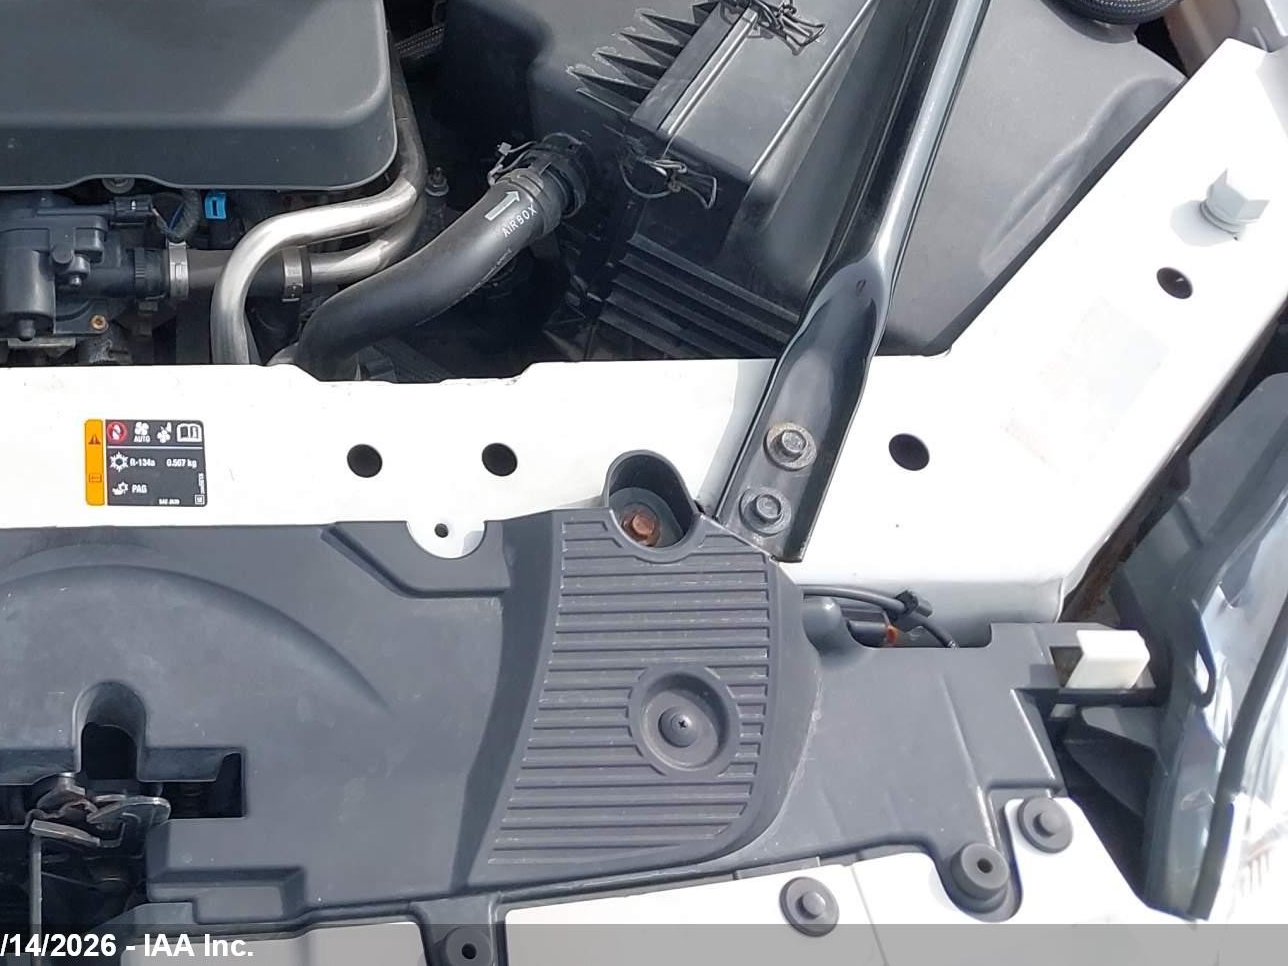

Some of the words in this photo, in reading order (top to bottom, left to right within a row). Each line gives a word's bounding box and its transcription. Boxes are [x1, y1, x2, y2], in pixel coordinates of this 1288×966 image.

[502, 204, 537, 238] AIRBOX
[133, 435, 150, 443] AUTO
[130, 458, 155, 467] R-134a
[187, 458, 197, 469] kg
[132, 484, 147, 494] PAG
